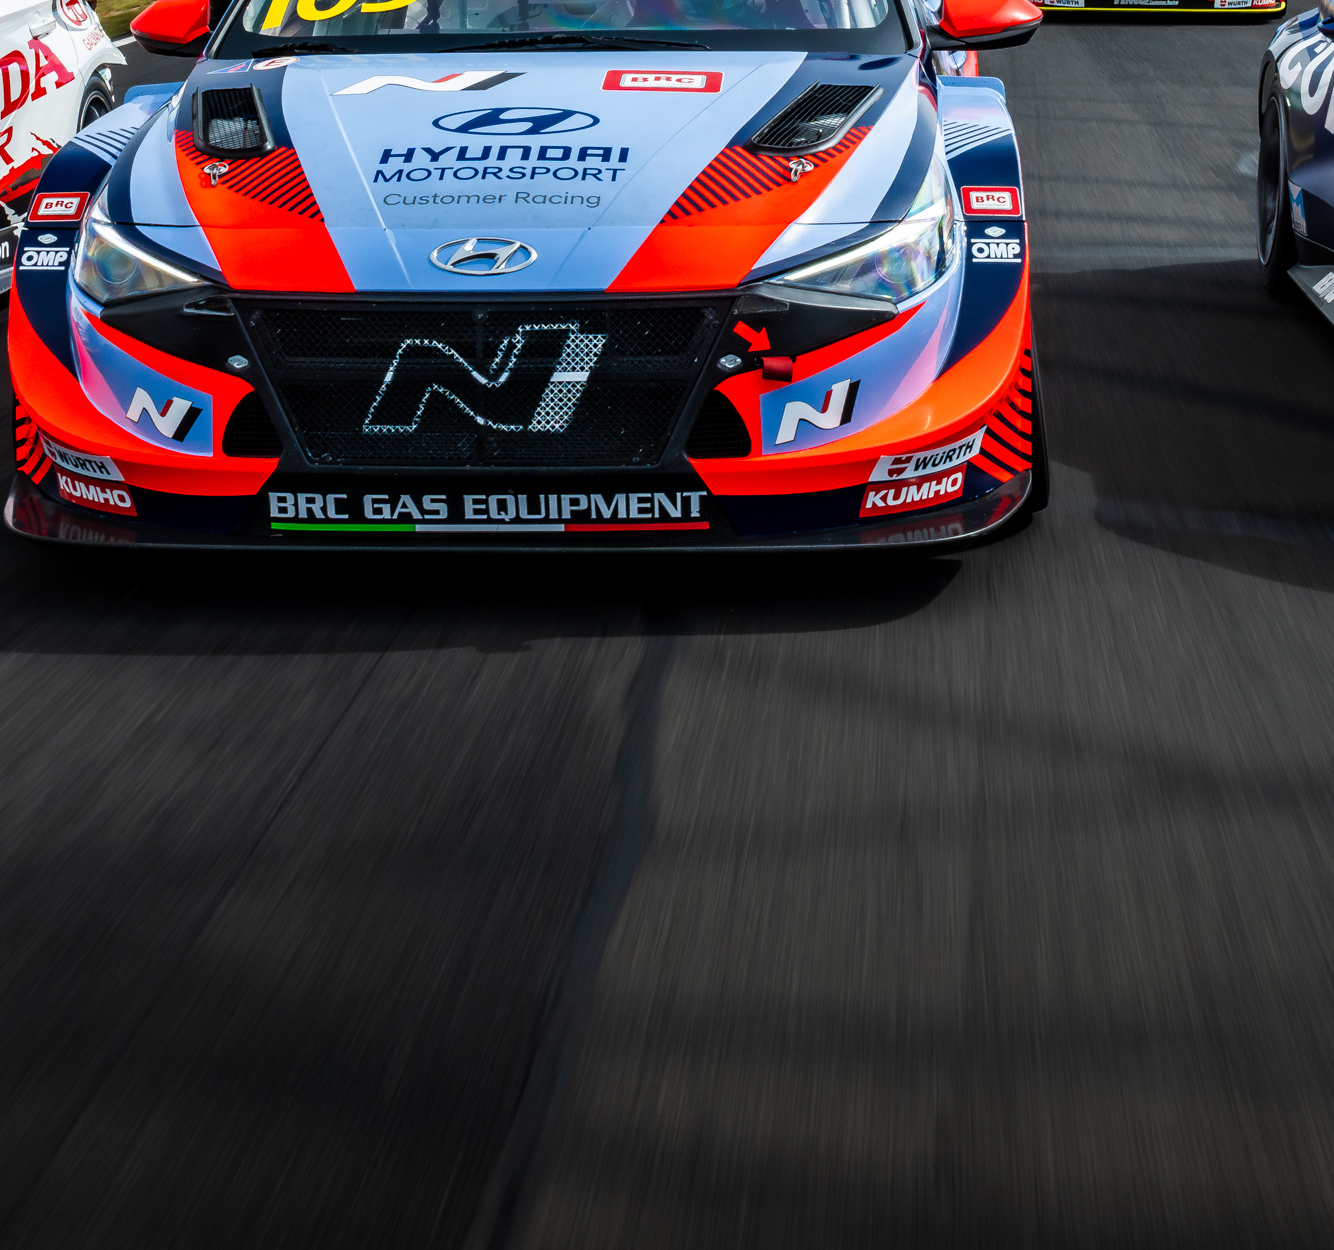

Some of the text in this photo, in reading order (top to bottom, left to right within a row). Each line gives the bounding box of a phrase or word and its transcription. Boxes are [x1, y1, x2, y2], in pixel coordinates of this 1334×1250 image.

[630, 75, 695, 84] BRC
[379, 145, 630, 165] HYUNDAI
[372, 166, 626, 184] MOTORSPORT
[44, 200, 74, 209] BRC
[383, 191, 602, 209] Customer Racing
[975, 194, 1006, 203] BRC
[21, 250, 68, 266] OMP
[971, 242, 1020, 259] OMP
[56, 448, 111, 476] WÜRTH
[913, 437, 975, 473] WÜRTH
[57, 472, 132, 509] KUMHO
[865, 471, 963, 509] KUMHO
[268, 490, 708, 522] BRC GAS EQUIPMENT
